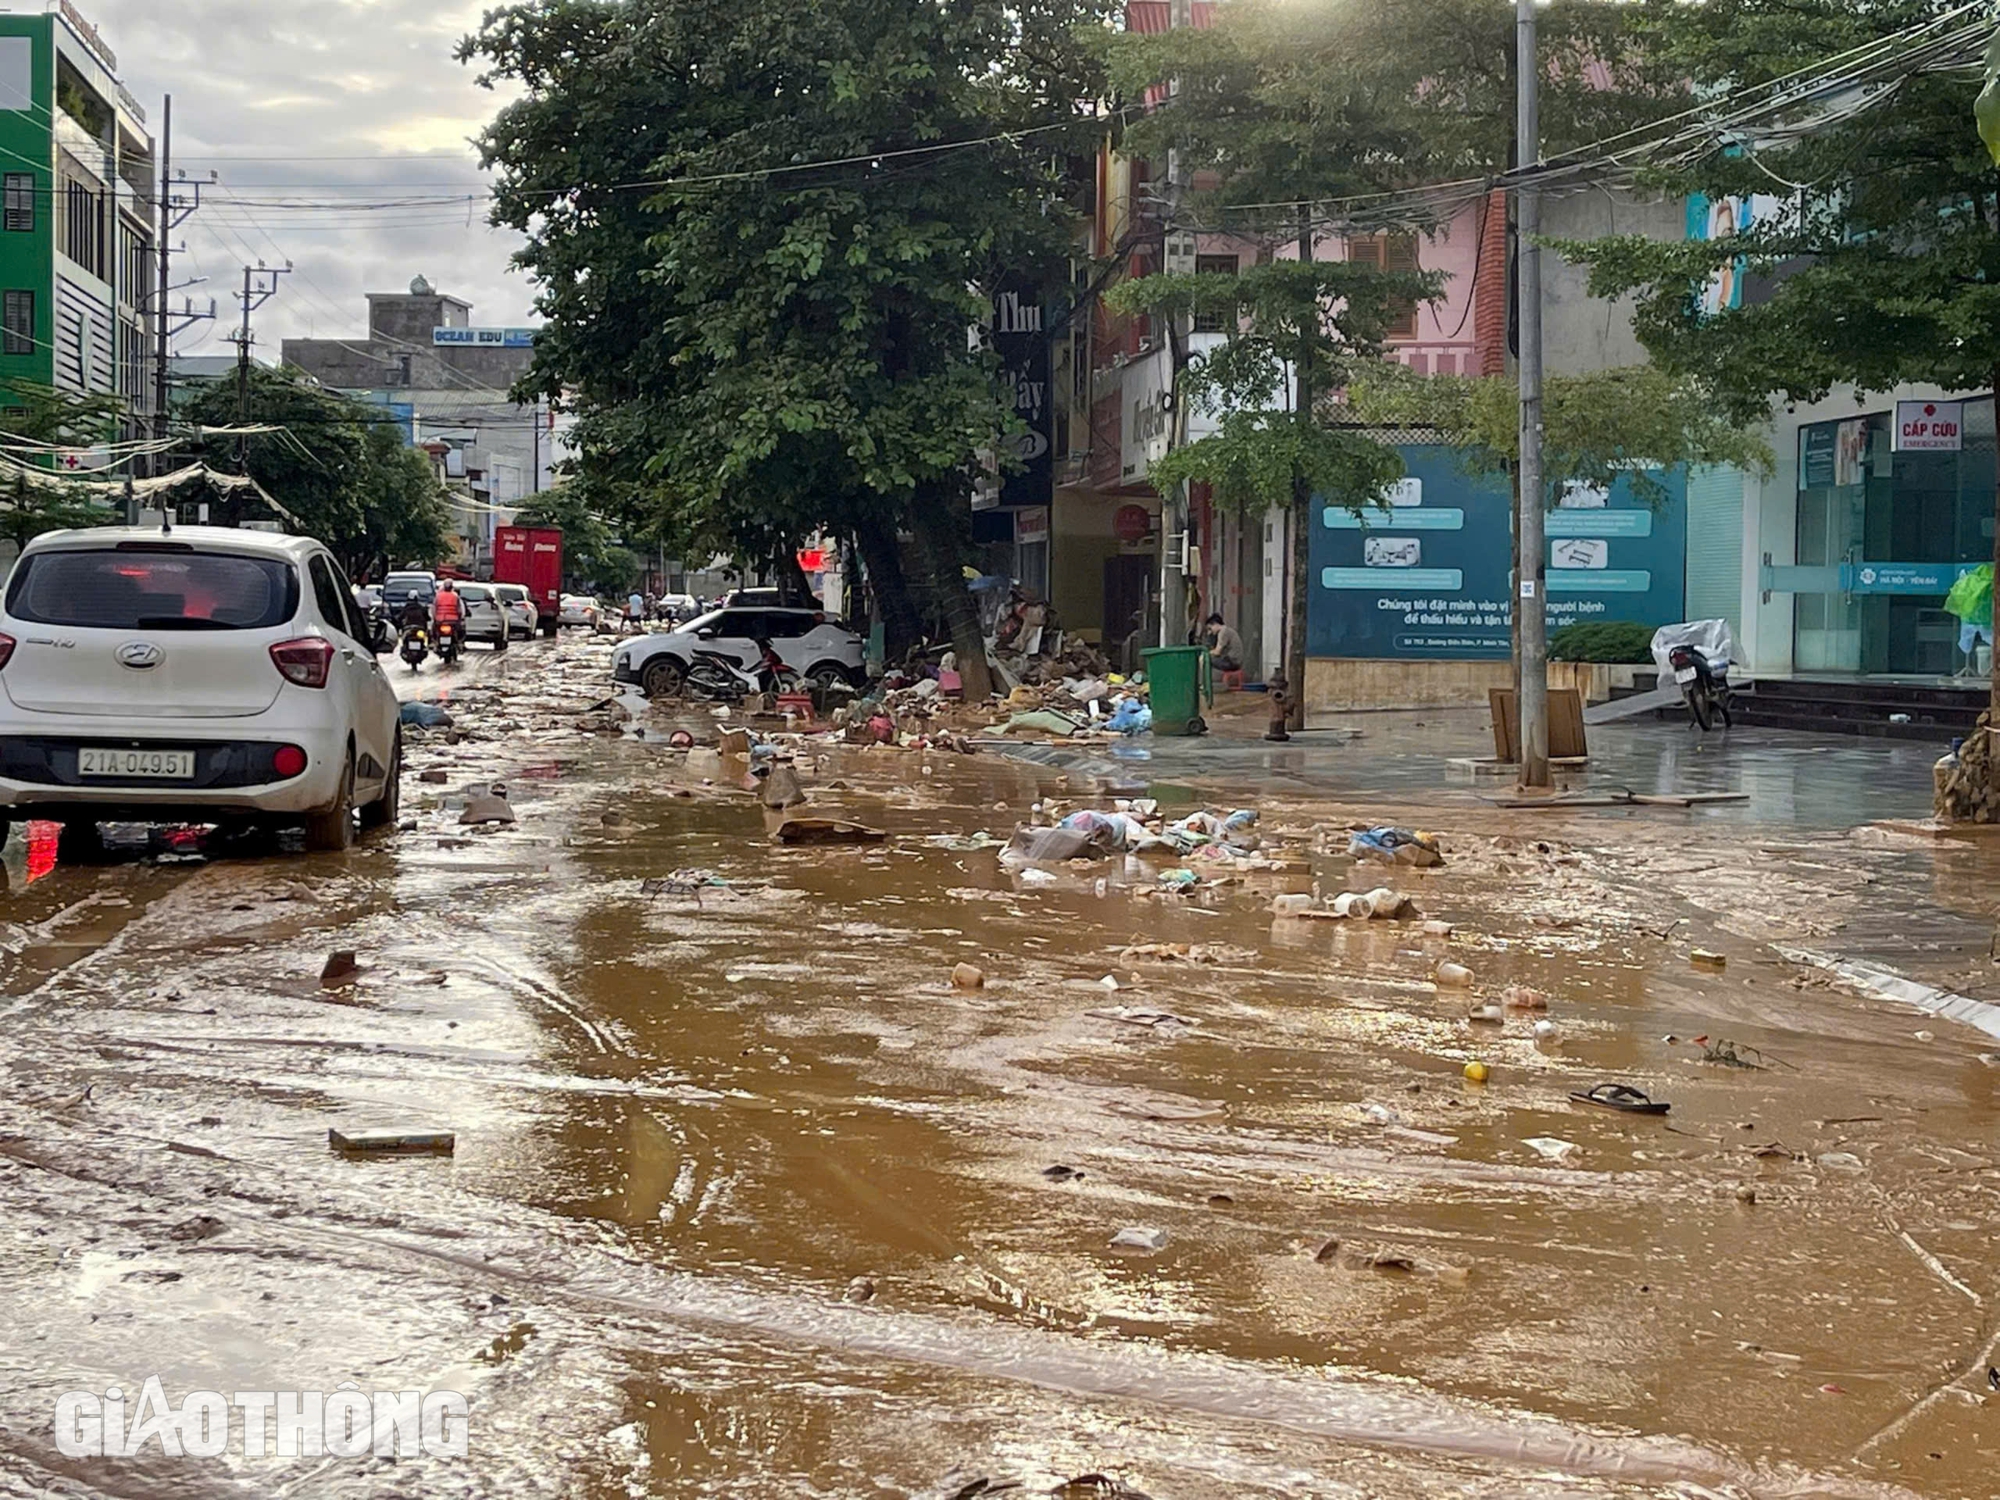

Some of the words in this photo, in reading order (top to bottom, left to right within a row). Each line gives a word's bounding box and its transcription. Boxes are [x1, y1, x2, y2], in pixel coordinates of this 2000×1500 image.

[996, 291, 1043, 332] Thu
[435, 331, 474, 342] OCEAN
[478, 332, 502, 342] EDU
[1903, 418, 1928, 437] CẤP
[1932, 419, 1958, 437] CỨU
[1377, 598, 1412, 612] Chúng
[1413, 599, 1428, 610] tôi
[1429, 599, 1448, 612] đặt
[1449, 600, 1476, 611] mình
[1477, 600, 1498, 611] vào
[1545, 600, 1577, 614] người
[1578, 601, 1606, 614] bệnh
[1404, 612, 1419, 624] để
[1420, 613, 1444, 625] thấu
[1445, 612, 1469, 625] hiểu
[1470, 613, 1483, 625] và
[1484, 614, 1501, 627] tận
[83, 752, 188, 774] 21A-049.51
